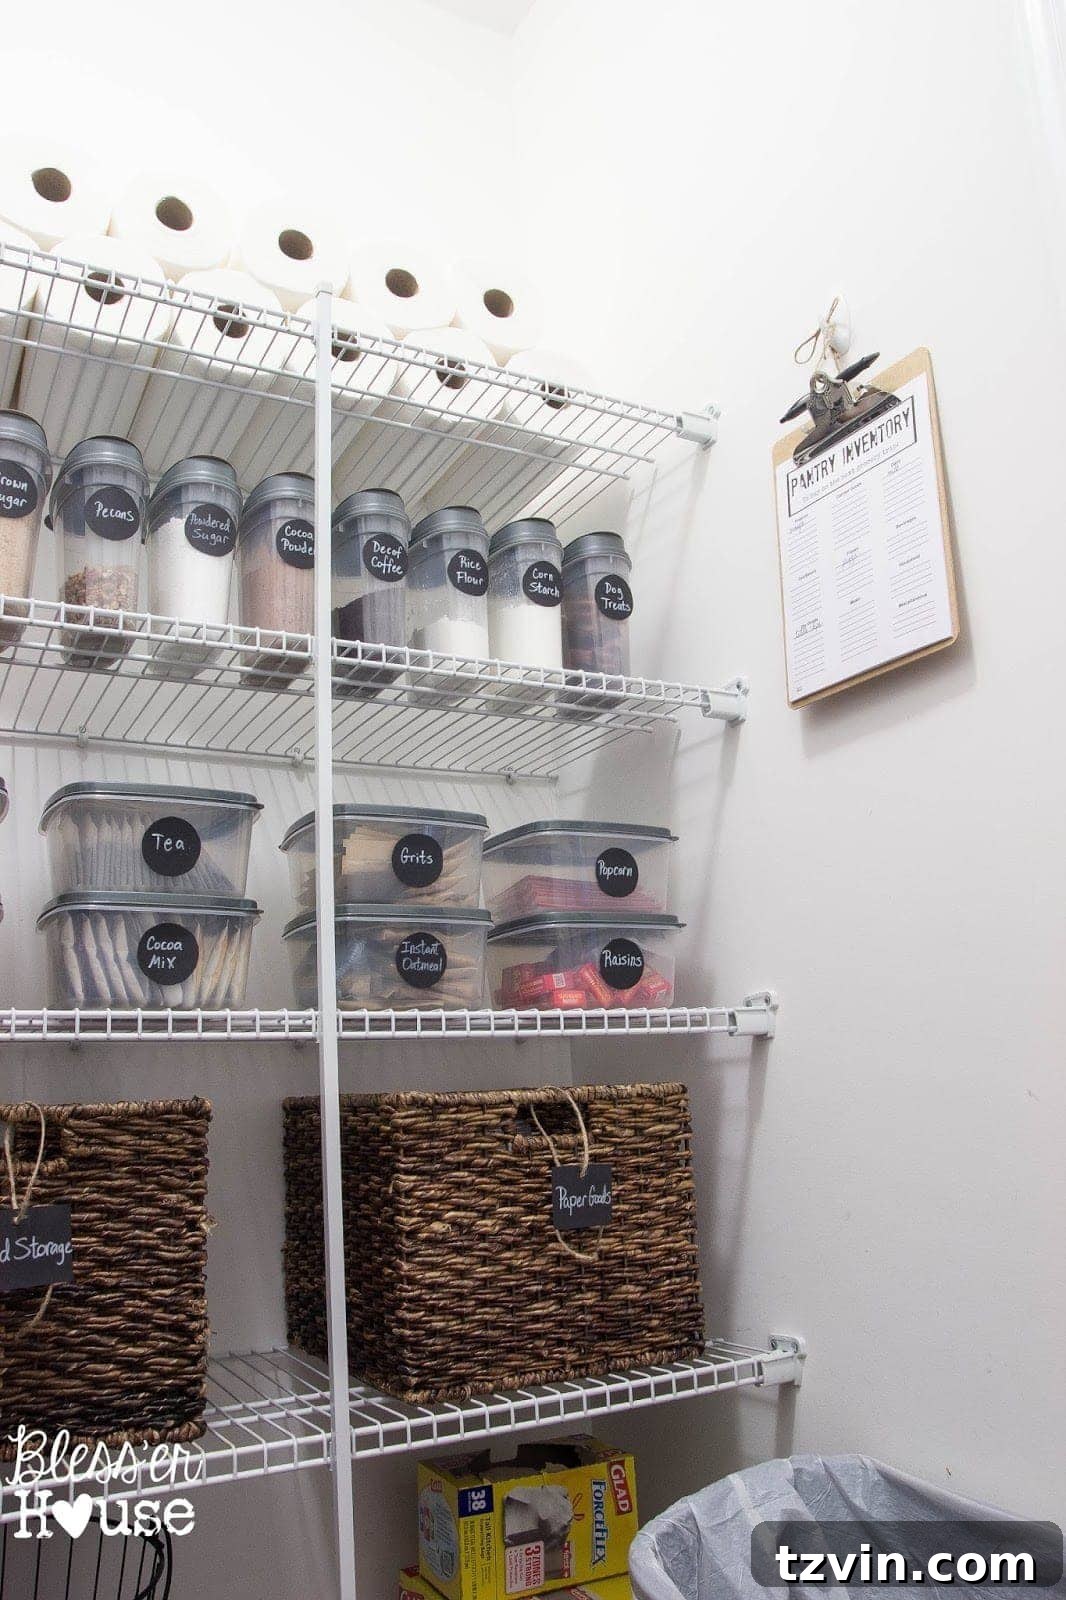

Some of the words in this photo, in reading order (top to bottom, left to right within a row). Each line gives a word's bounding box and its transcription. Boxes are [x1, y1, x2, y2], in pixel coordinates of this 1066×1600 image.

[791, 454, 836, 496] PANTRY
[842, 407, 910, 464] INVENTORY
[0, 472, 28, 492] rown
[0, 493, 28, 509] ugar
[94, 500, 135, 522] Pecans
[188, 512, 231, 533] Powdered
[191, 529, 230, 546] Sugar
[284, 525, 314, 541] Cocoa
[280, 537, 314, 556] Powde
[372, 540, 404, 559] Decaf
[371, 555, 404, 575] Coffee
[458, 555, 482, 571] Rice
[456, 571, 484, 586] Flour
[532, 567, 554, 582] Corn
[528, 581, 560, 598] Starch
[604, 581, 624, 600] Dog
[600, 597, 631, 612] Treats
[152, 833, 185, 851] Tea
[400, 846, 434, 864] Grits
[597, 859, 633, 878] Popcorn
[146, 935, 183, 952] Cocoa
[401, 939, 441, 956] Instant
[147, 953, 176, 969] Mix
[401, 957, 443, 972] Oatmeal
[602, 949, 643, 967] Raisins
[555, 1185, 587, 1217] Paper
[588, 1184, 611, 1207] Goods
[13, 1235, 73, 1266] Storage
[610, 1463, 631, 1512] GLAD
[470, 1489, 486, 1512] 38
[591, 1479, 608, 1567] FORCEFLEX
[524, 1545, 541, 1557] 3
[525, 1557, 533, 1587] STRONG
[531, 1555, 541, 1586] ZONES
